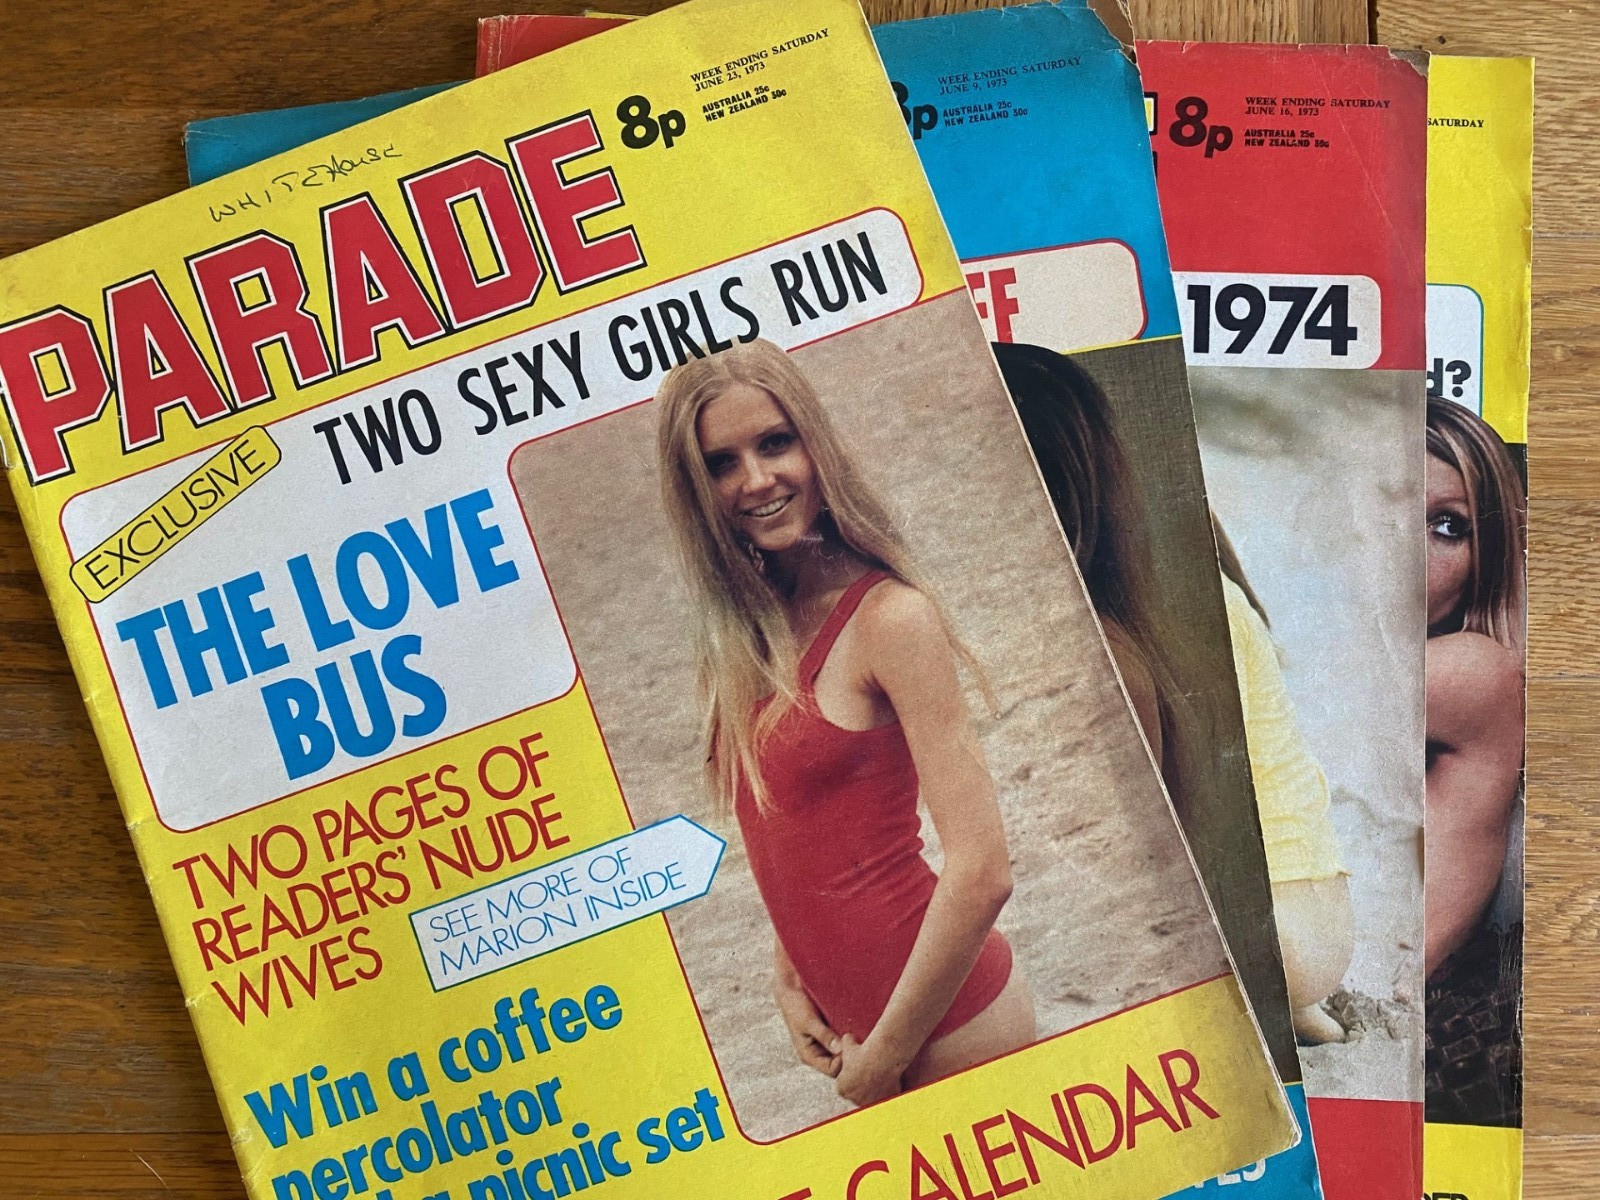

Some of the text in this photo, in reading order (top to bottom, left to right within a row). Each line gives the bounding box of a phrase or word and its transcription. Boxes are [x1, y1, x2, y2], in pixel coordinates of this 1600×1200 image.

[690, 28, 829, 82] WEEK ENDING SATURDAY
[695, 62, 766, 92] JUNE 23, 1973
[938, 56, 1081, 85] WEEK ENDING SATURDAY
[702, 85, 770, 113] AUSTRALIA 25c
[705, 109, 725, 122] NEW
[729, 94, 769, 115] ZEALAND
[939, 78, 1008, 96] JUNE 9, 1973
[943, 100, 1012, 118] AUSTRALIA 25c
[1245, 97, 1390, 109] WEEK ENDING SATURDAY
[1245, 106, 1319, 116] JUNE 16, 1973
[616, 95, 686, 149] 8p
[945, 117, 964, 127] NEW
[969, 110, 1009, 123] ZEALAND
[1168, 96, 1233, 159] 8p
[1244, 129, 1295, 138] AUSTRALIA
[1244, 138, 1264, 147] NEW
[1269, 139, 1310, 148] ZEALAND
[1427, 117, 1484, 128] SATURDAY
[0, 109, 647, 487] PARADE
[1187, 283, 1357, 356] 1974
[314, 231, 888, 485] TWO SEXY GIRLS RUN
[84, 438, 266, 590] EXCLUSIVE
[116, 488, 520, 709] THE LOVE
[261, 634, 447, 781] BUS
[172, 732, 550, 911] TWO PAGES OF
[192, 793, 570, 972] READERS' NUDE
[429, 846, 632, 943] SEE MORE OF
[440, 861, 687, 976] MARION INSIDE
[211, 926, 383, 1026] WIVES
[243, 984, 622, 1151] Win a coffee
[636, 1088, 726, 1165] set
